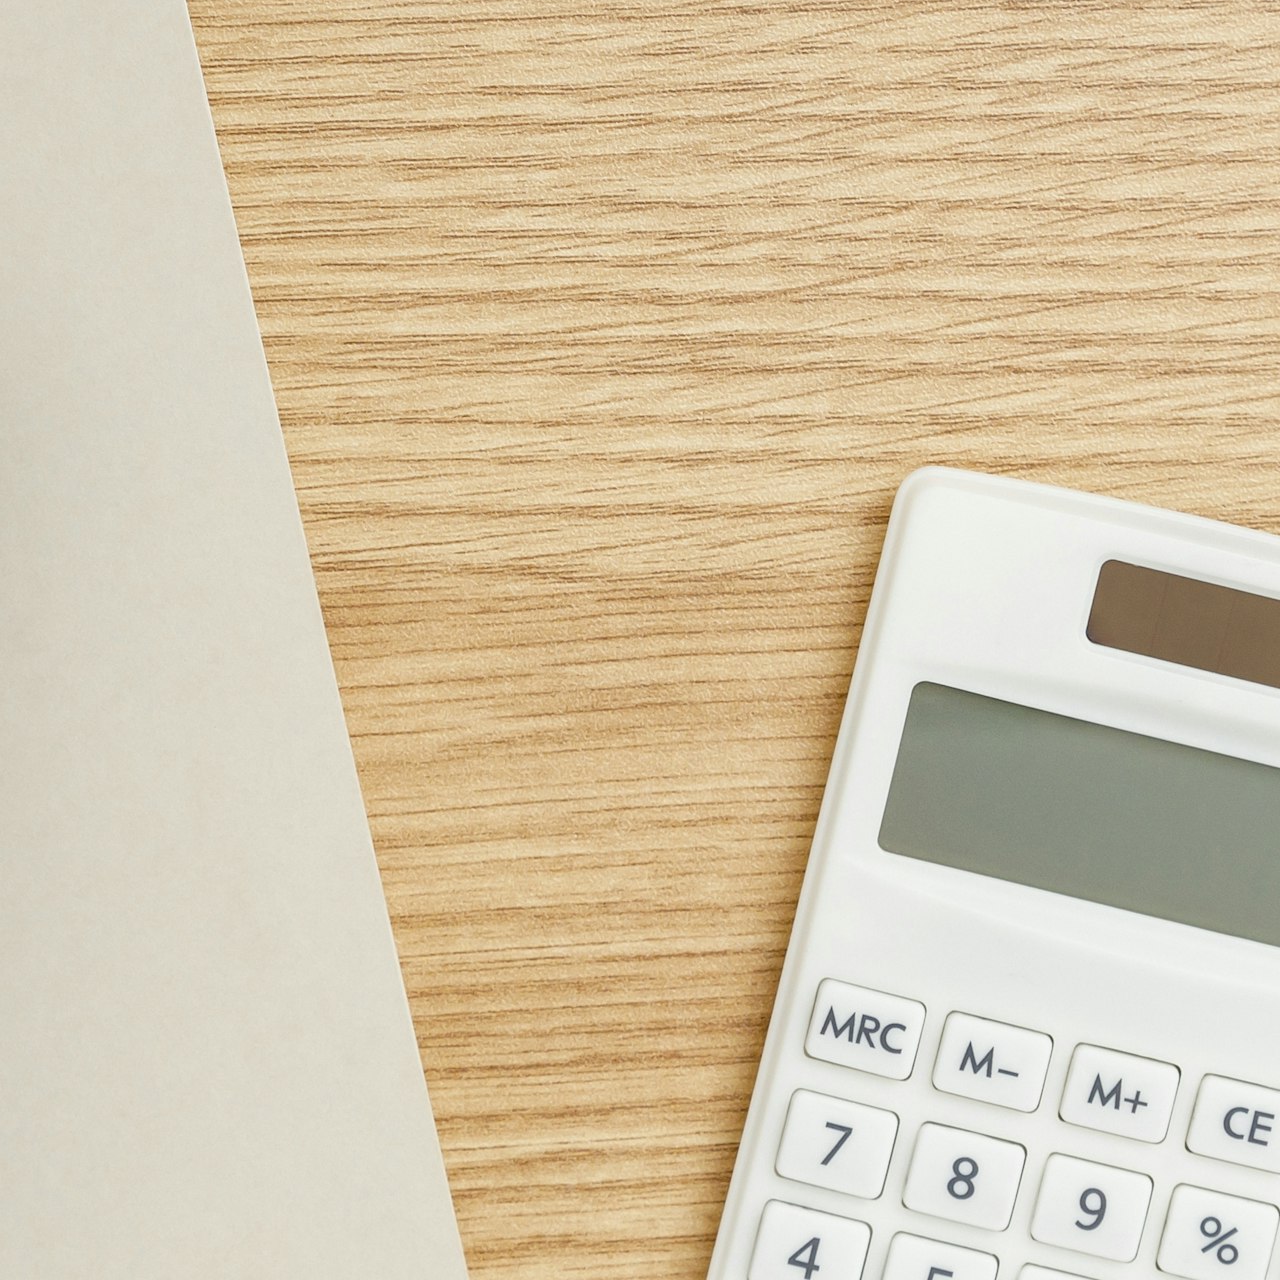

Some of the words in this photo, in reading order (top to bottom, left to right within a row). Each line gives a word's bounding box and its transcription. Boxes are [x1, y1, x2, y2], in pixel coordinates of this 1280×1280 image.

[819, 1005, 907, 1056] MRC
[1087, 1072, 1148, 1114] M+
[820, 1121, 853, 1166] 7
[1222, 1106, 1275, 1147] CE
[946, 1156, 979, 1200] 8
[1074, 1187, 1107, 1231] 9
[787, 1236, 821, 1280] 4
[1199, 1216, 1239, 1265] %
